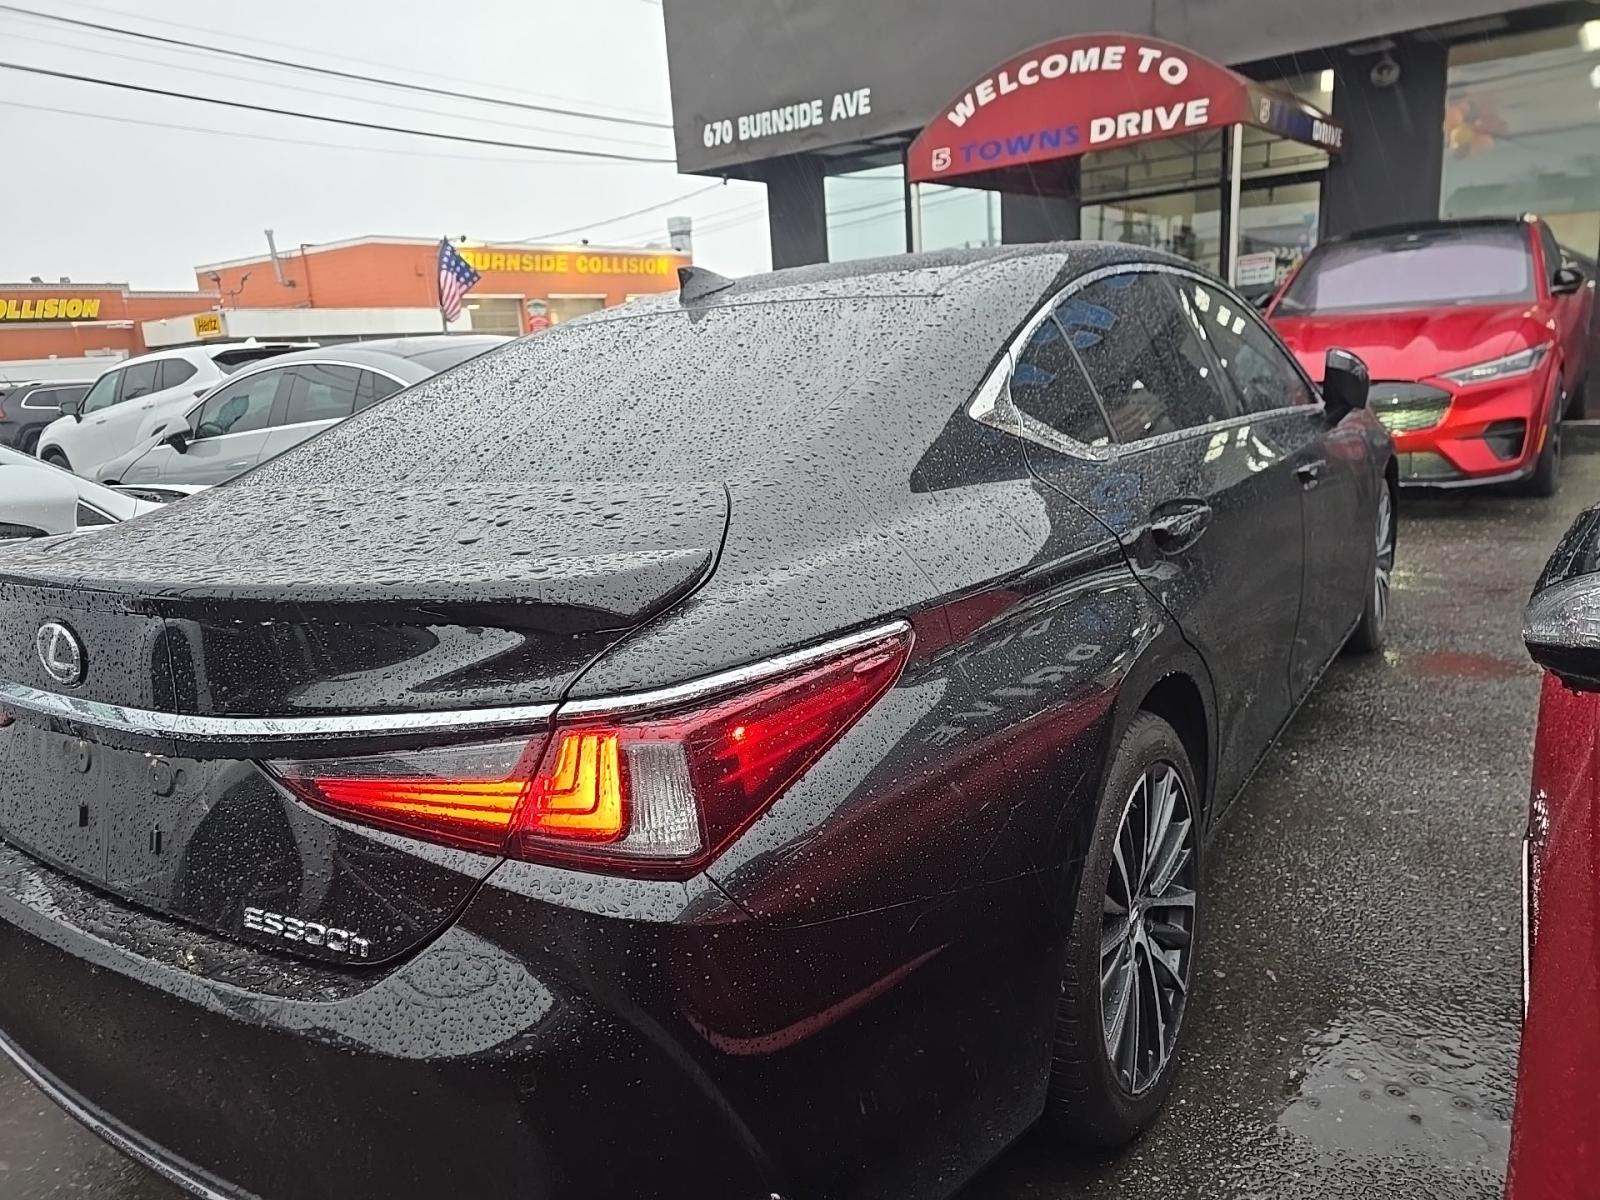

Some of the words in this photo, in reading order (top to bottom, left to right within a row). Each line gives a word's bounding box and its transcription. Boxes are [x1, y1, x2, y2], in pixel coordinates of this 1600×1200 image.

[703, 119, 733, 148] 670
[738, 99, 824, 141] BURNSIDE
[831, 87, 871, 122] AVE
[947, 46, 1127, 128] WELCOME
[1138, 46, 1189, 85] TO
[931, 147, 951, 172] 5
[960, 124, 1081, 163] TOWNS
[1089, 97, 1210, 144] DRIVE
[575, 255, 669, 275] COLLISION
